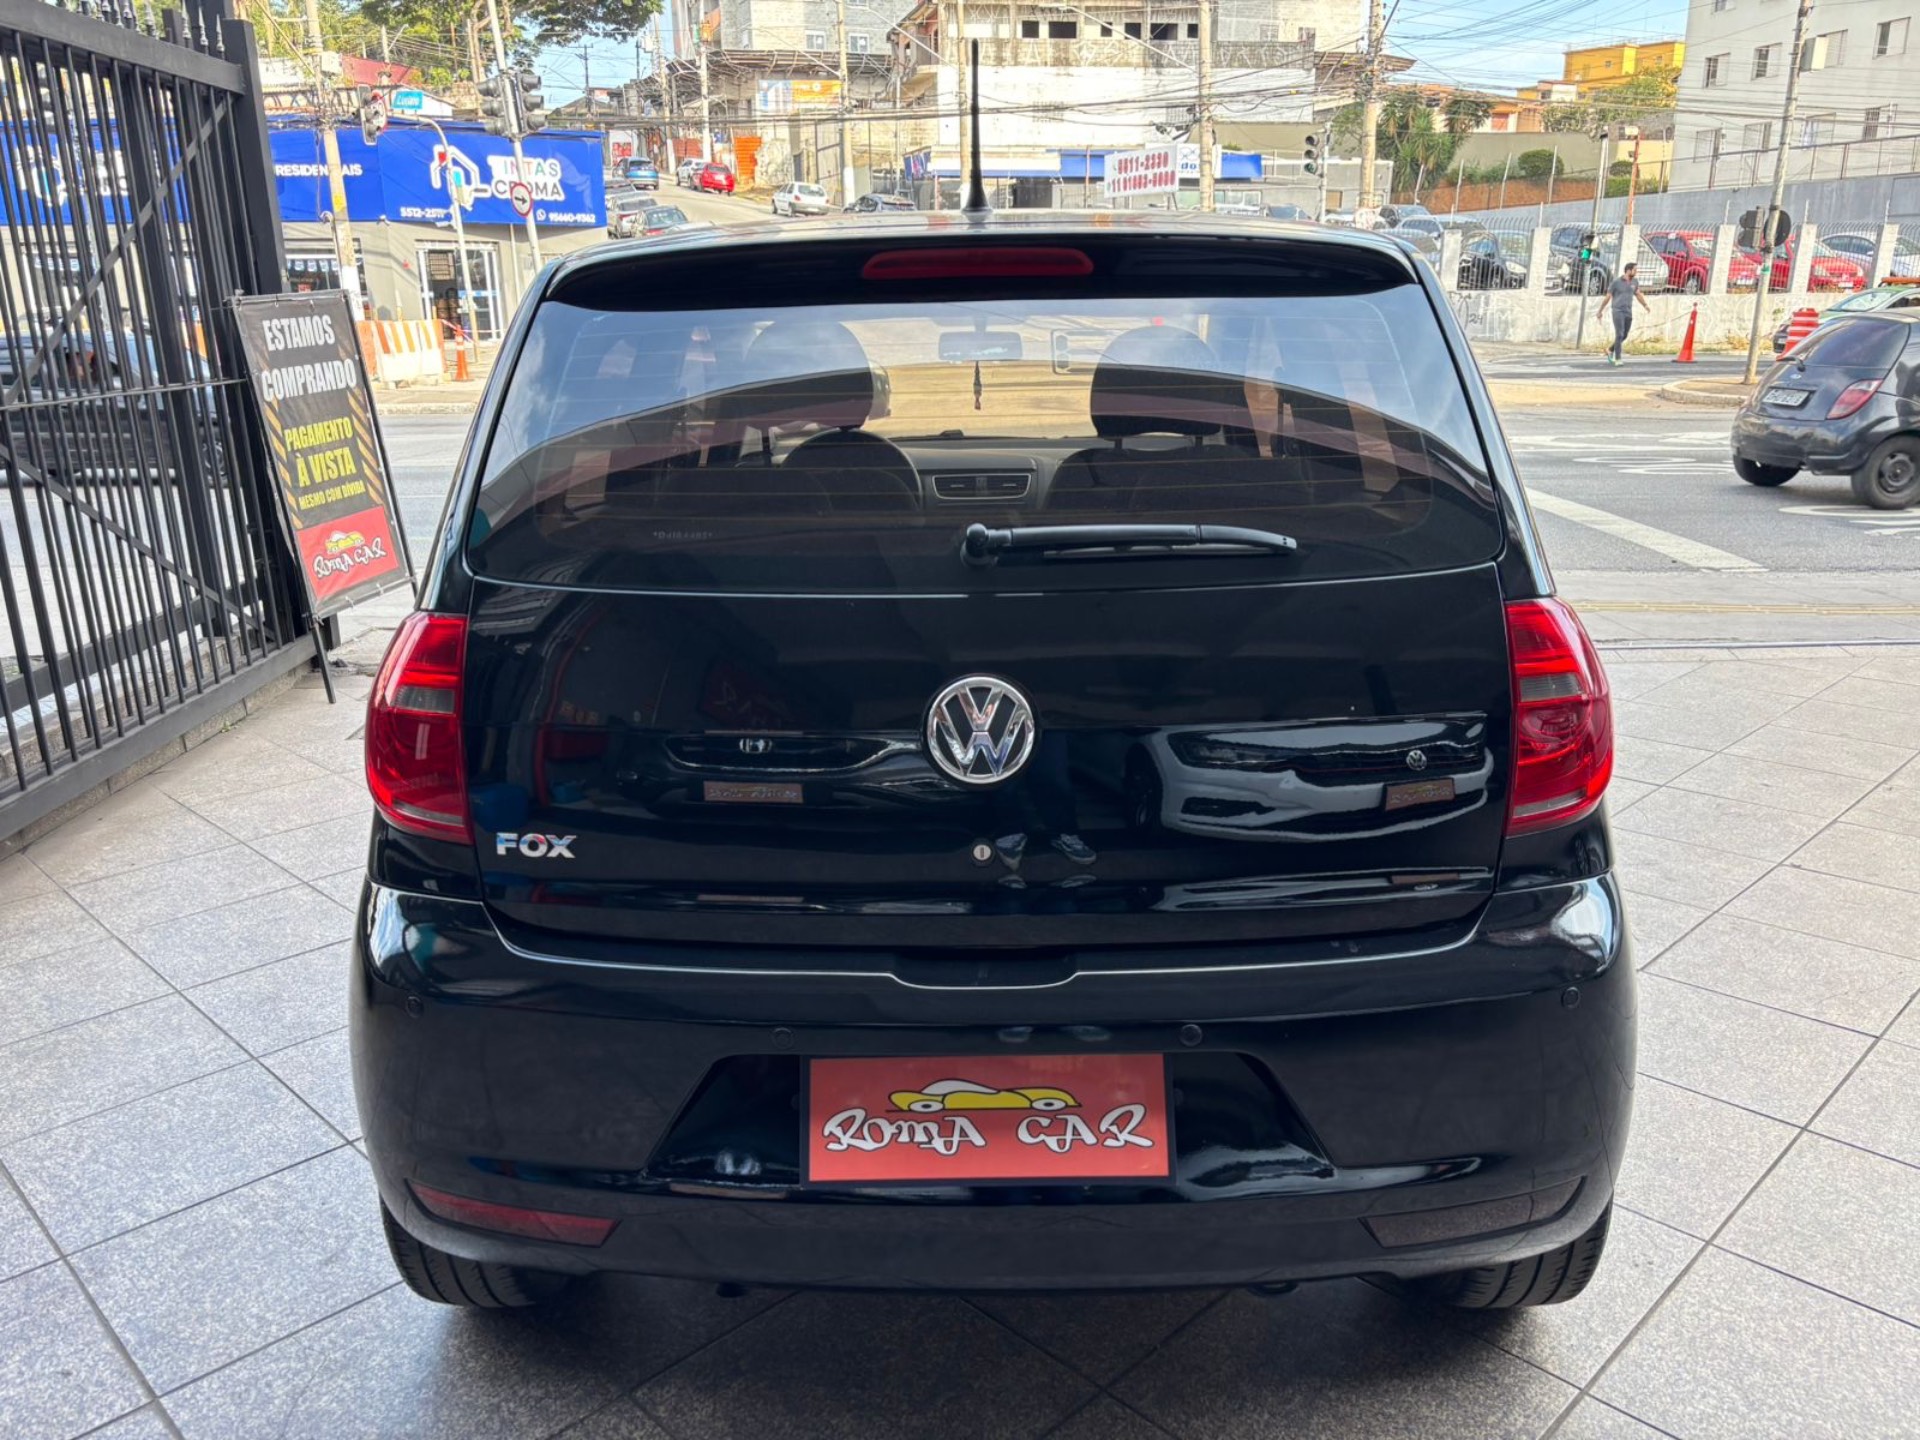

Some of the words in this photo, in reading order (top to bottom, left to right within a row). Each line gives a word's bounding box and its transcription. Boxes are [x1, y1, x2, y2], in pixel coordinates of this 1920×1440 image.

[275, 164, 363, 176] RESIDENAIS
[490, 160, 559, 177] INTAS
[262, 314, 336, 351] ESTAMOS
[261, 358, 357, 402] COMPRANDO
[284, 417, 353, 452] PAGAMENTO
[295, 452, 311, 487] À
[308, 447, 357, 484] VISTA
[299, 490, 326, 510] MESMO
[325, 486, 343, 503] COM
[496, 832, 577, 859] FOX
